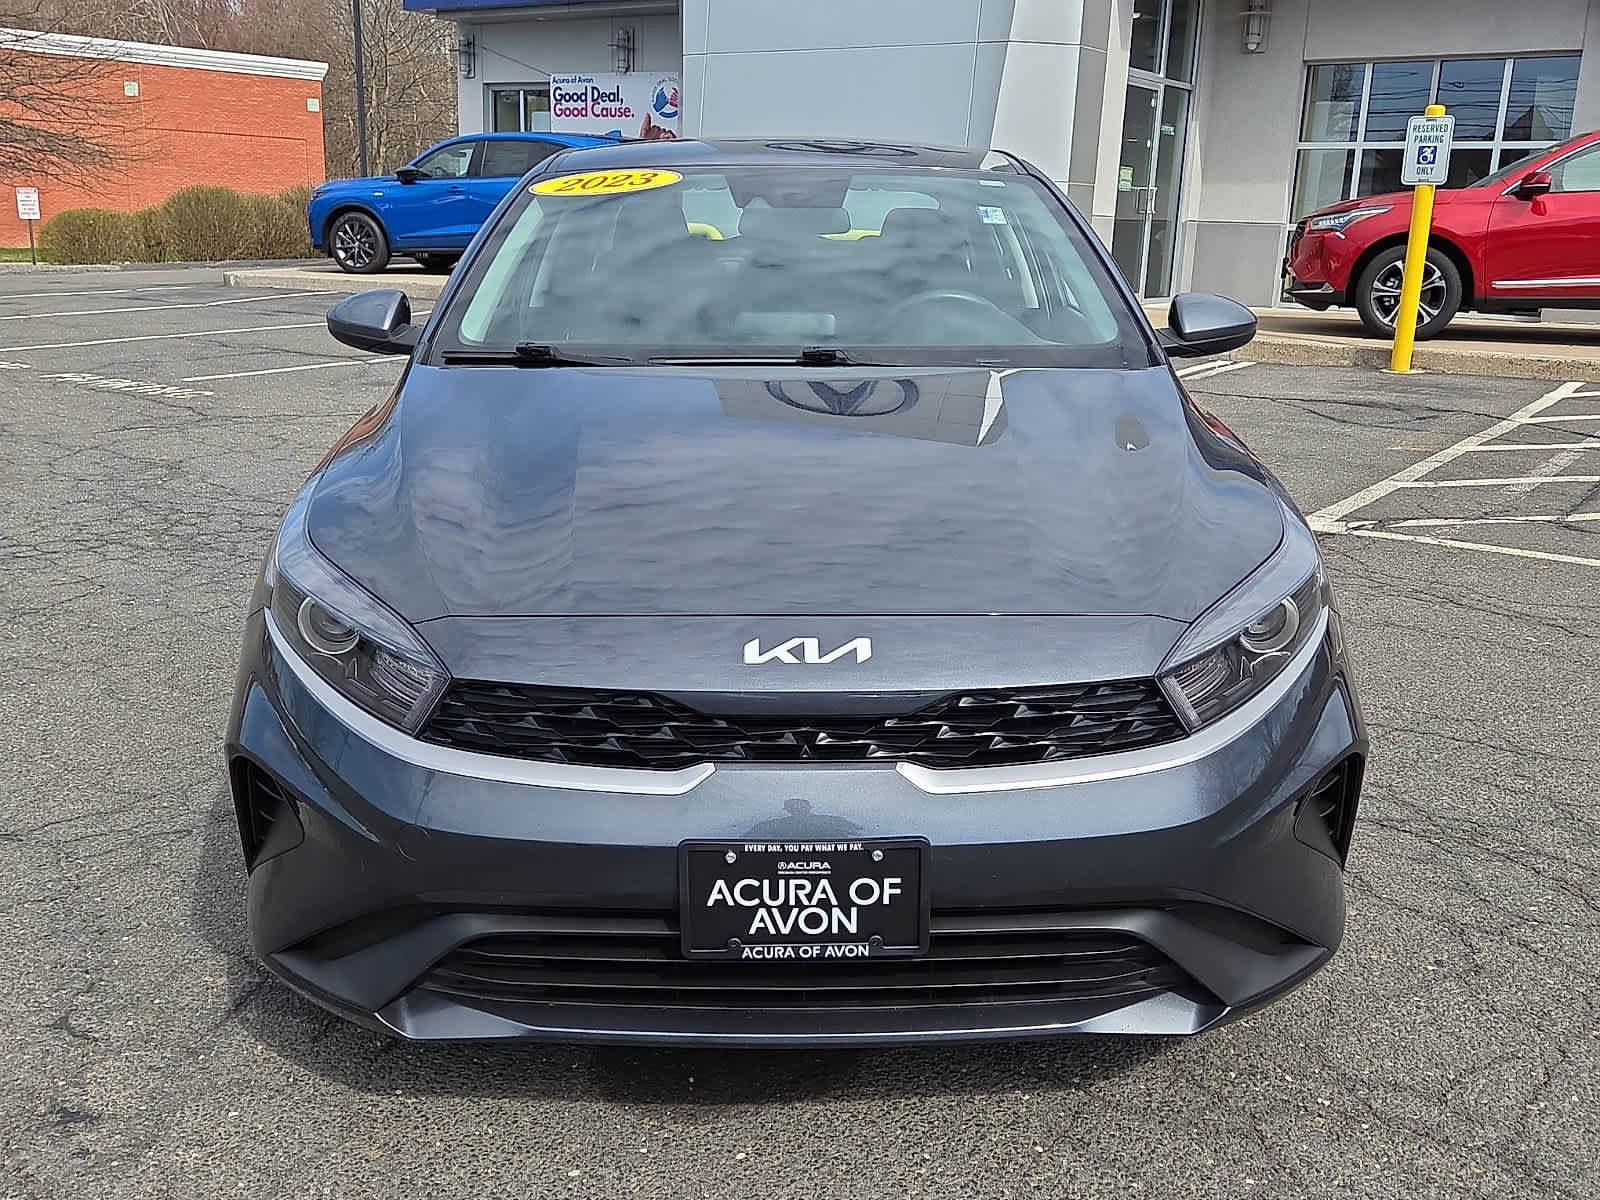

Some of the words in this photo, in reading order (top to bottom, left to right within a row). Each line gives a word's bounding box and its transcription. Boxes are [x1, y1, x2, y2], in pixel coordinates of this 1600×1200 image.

[552, 76, 569, 84] Acura
[571, 76, 577, 84] of
[578, 76, 594, 84] Avon
[553, 86, 588, 103] Good
[591, 85, 624, 105] Deal,
[553, 102, 588, 118] Good
[591, 102, 635, 118] Cause.
[1412, 124, 1449, 133] RESERVED
[1413, 135, 1445, 144] PARKING
[1416, 166, 1435, 176] ONLY
[553, 172, 659, 192] 2023
[744, 636, 872, 664] KIA
[744, 844, 766, 852] EVERY
[784, 844, 800, 852] YOU
[801, 844, 814, 852] PAY
[815, 843, 835, 852] WHAT
[837, 843, 848, 851] WE
[849, 843, 864, 851] PAY.
[786, 861, 832, 870] ACURA
[706, 878, 838, 907] ACURA
[848, 877, 902, 906] OF
[748, 907, 858, 936] AVON
[741, 946, 796, 959] ACURA
[799, 945, 821, 958] OF
[824, 945, 870, 958] AVON
